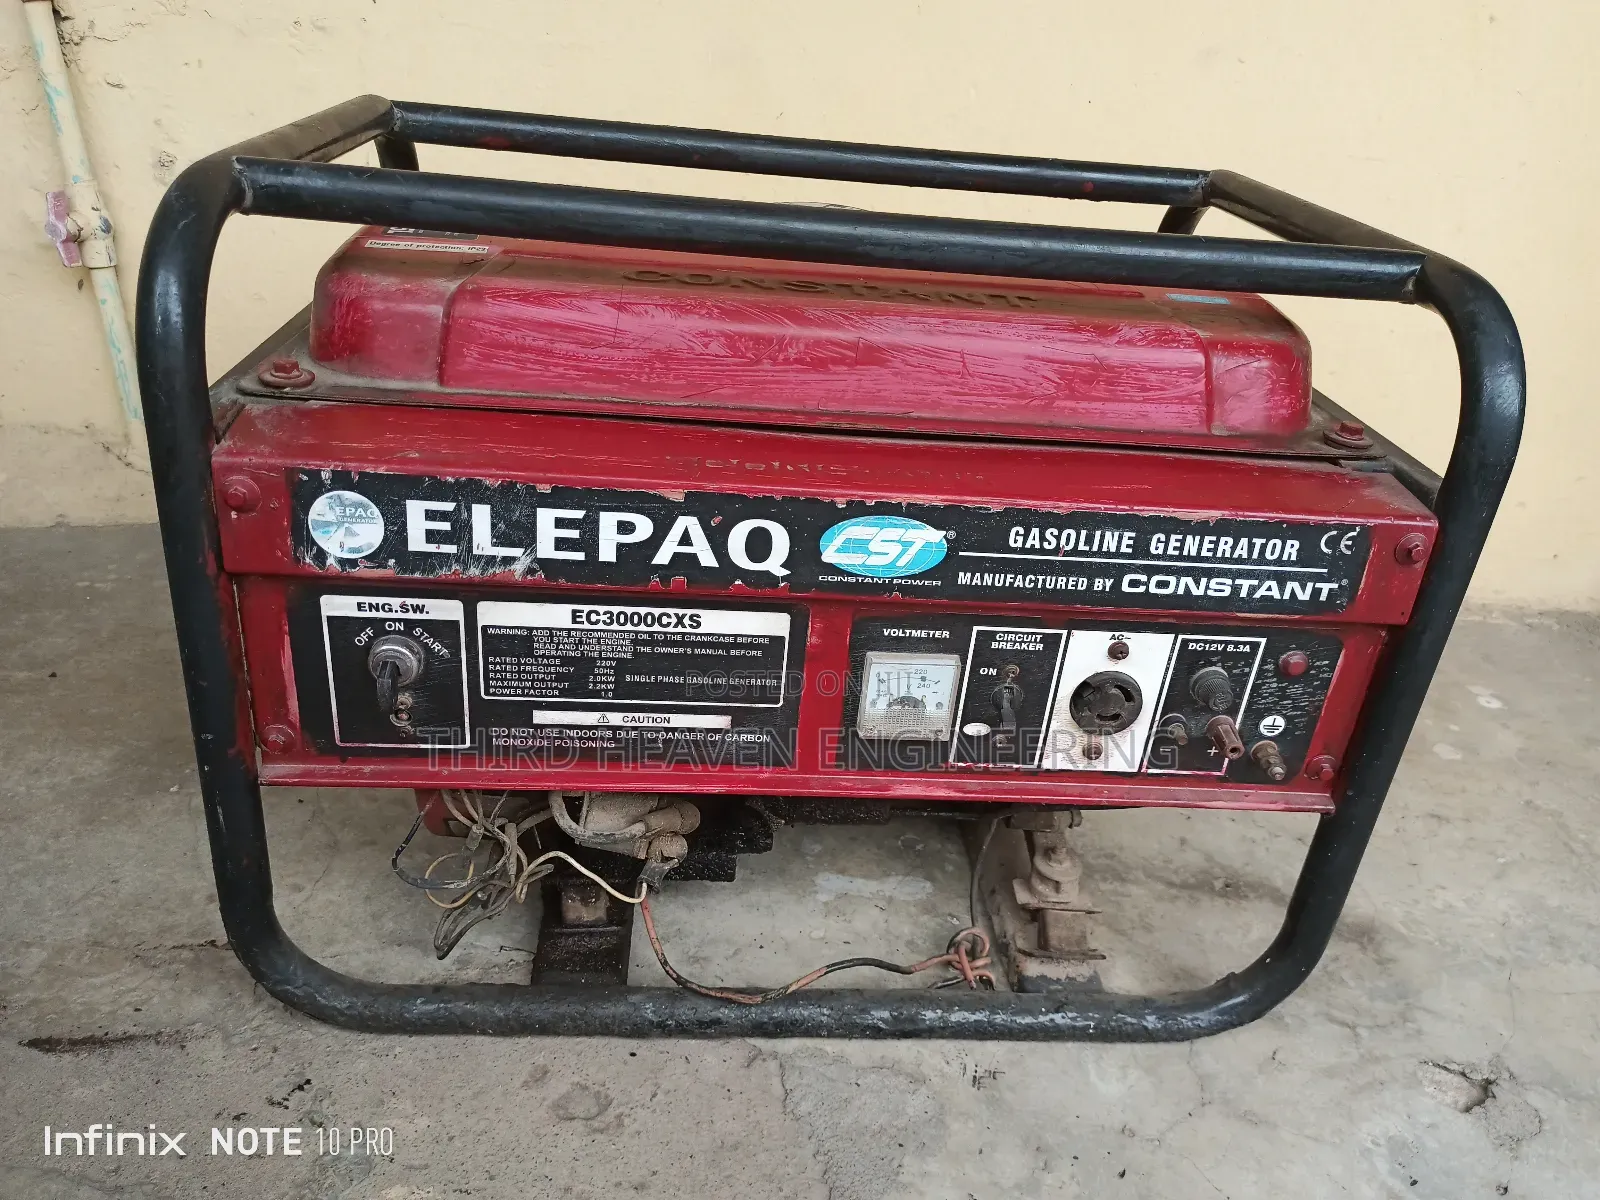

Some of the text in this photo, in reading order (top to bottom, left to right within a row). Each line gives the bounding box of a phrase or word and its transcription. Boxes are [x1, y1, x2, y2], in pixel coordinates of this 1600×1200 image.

[406, 500, 791, 576] ELEPAQ
[1009, 526, 1300, 561] GASOLINE GENERATOR
[821, 526, 946, 566] CST
[818, 575, 942, 587] CONSTANT POWER
[957, 571, 1338, 601] MANUFACTURED BY CONSTANT
[357, 601, 429, 614] ENG.SW.
[571, 609, 702, 629] EC3000CXS
[385, 621, 404, 631] ON
[354, 627, 375, 646] OFF
[487, 628, 530, 636] WARNING:
[570, 631, 635, 639] RECOMMENDED
[653, 633, 664, 641] TO
[684, 635, 735, 643] CRANKCASE
[737, 636, 770, 644] BEFORE
[883, 628, 950, 639] VOLTMETER
[996, 633, 1043, 642] CIRCUIT
[413, 628, 450, 658] START
[600, 638, 634, 646] ENGINE.
[991, 642, 1044, 651] BREAKER
[1188, 642, 1251, 653] DC12V 8.3A
[578, 644, 634, 652] UNDERSTAND
[694, 648, 728, 656] MANUAL
[730, 649, 763, 657] BEFORE
[601, 651, 635, 659] ENGINE.
[520, 657, 561, 665] VOLTAGE
[489, 664, 518, 672] RATED
[520, 665, 575, 673] FREQUENCY
[980, 667, 998, 676] ON
[489, 672, 519, 680] RATED
[521, 673, 556, 681] OUTPUT
[625, 674, 777, 687] SINGLE PHASE GASOLINE GENERATOR
[489, 680, 532, 688] MAXIMUM
[534, 681, 570, 689] OUTPUT
[622, 715, 671, 725] CAUTION
[492, 727, 771, 743] DO NOT USE INDOORS DUE TO DANGER OF CARBON
[492, 738, 616, 748] MONOXIDE POISONING
